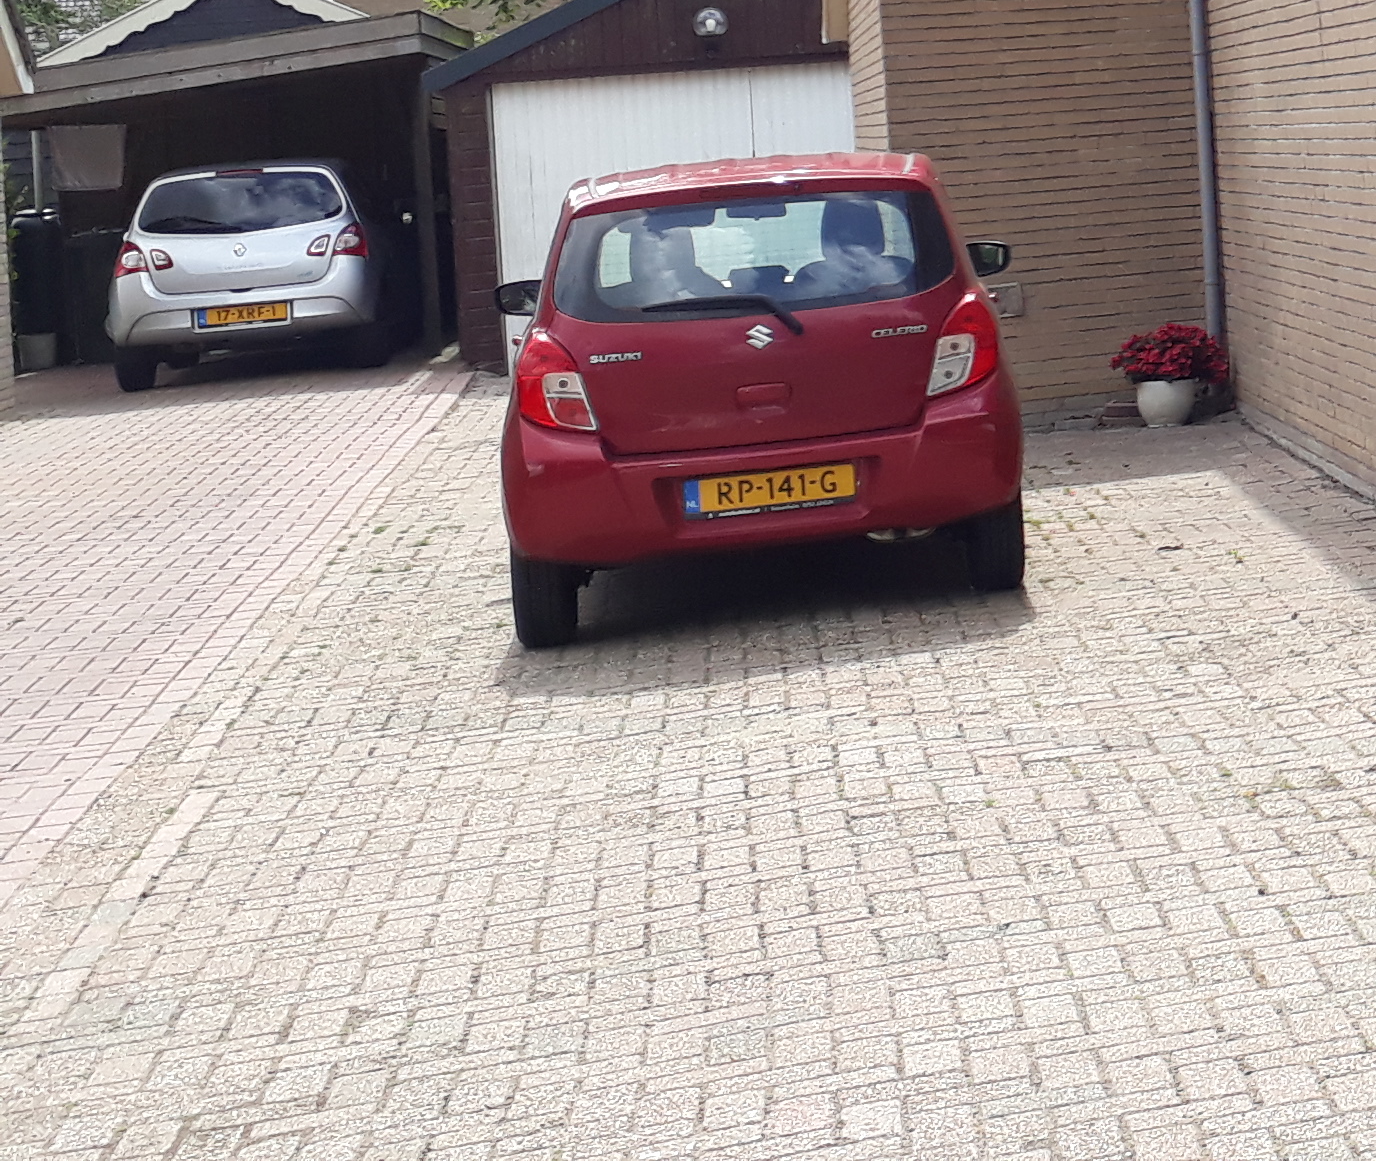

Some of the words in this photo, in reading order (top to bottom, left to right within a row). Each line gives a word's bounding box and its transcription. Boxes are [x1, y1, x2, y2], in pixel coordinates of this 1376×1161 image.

[590, 351, 642, 364] SUZUKI
[717, 470, 838, 506] RP-141-G
[686, 500, 699, 508] NL
